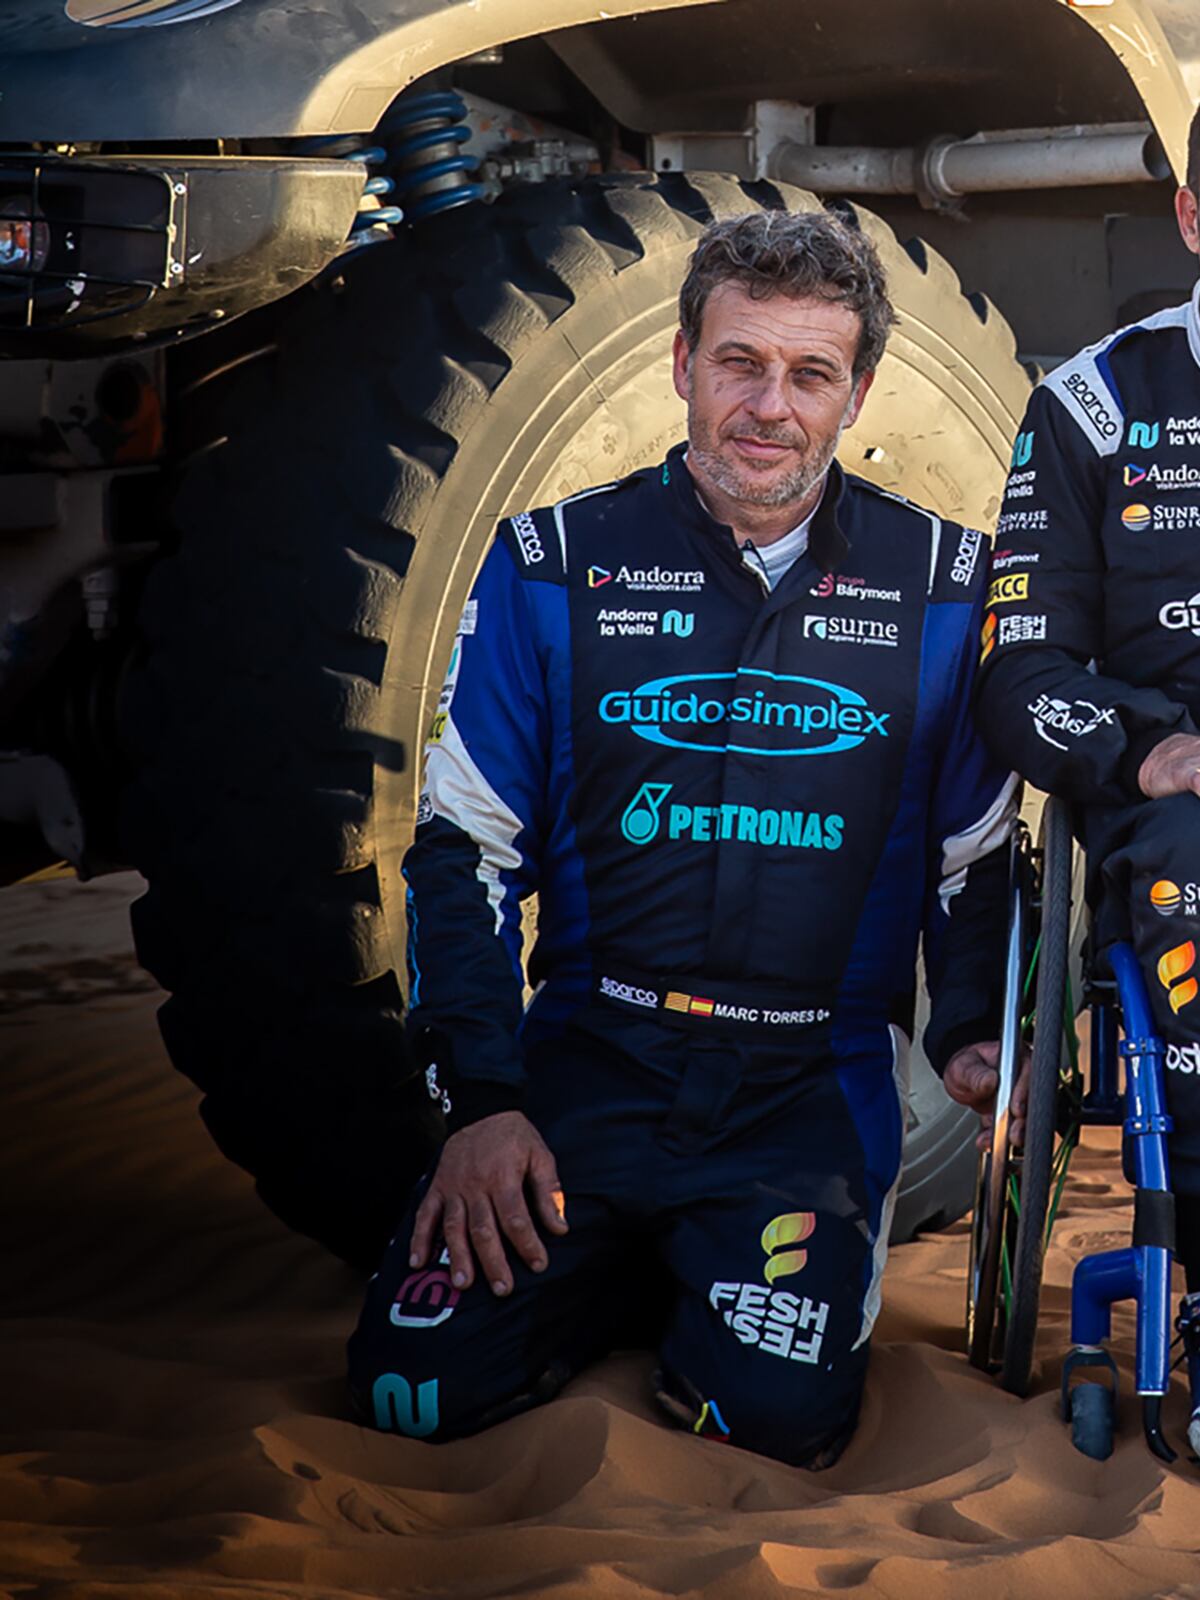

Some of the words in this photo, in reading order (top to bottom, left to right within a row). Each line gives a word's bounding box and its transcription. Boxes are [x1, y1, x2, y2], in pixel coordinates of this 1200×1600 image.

[1065, 373, 1118, 438] sparco
[1169, 431, 1185, 445] la
[950, 527, 980, 584] sparc
[615, 565, 706, 584] Andorra
[991, 577, 1026, 600] ACC
[597, 608, 659, 622] Andorra
[999, 614, 1047, 632] FESH
[601, 623, 616, 636] la
[617, 623, 655, 636] Vella
[828, 616, 898, 640] surne
[598, 689, 891, 738] Guidosimplex
[668, 803, 845, 851] PETRONAS
[600, 976, 658, 1008] sparco
[714, 1003, 759, 1022] MARC
[762, 1010, 815, 1025] TORRES
[709, 1281, 830, 1335] FESH
